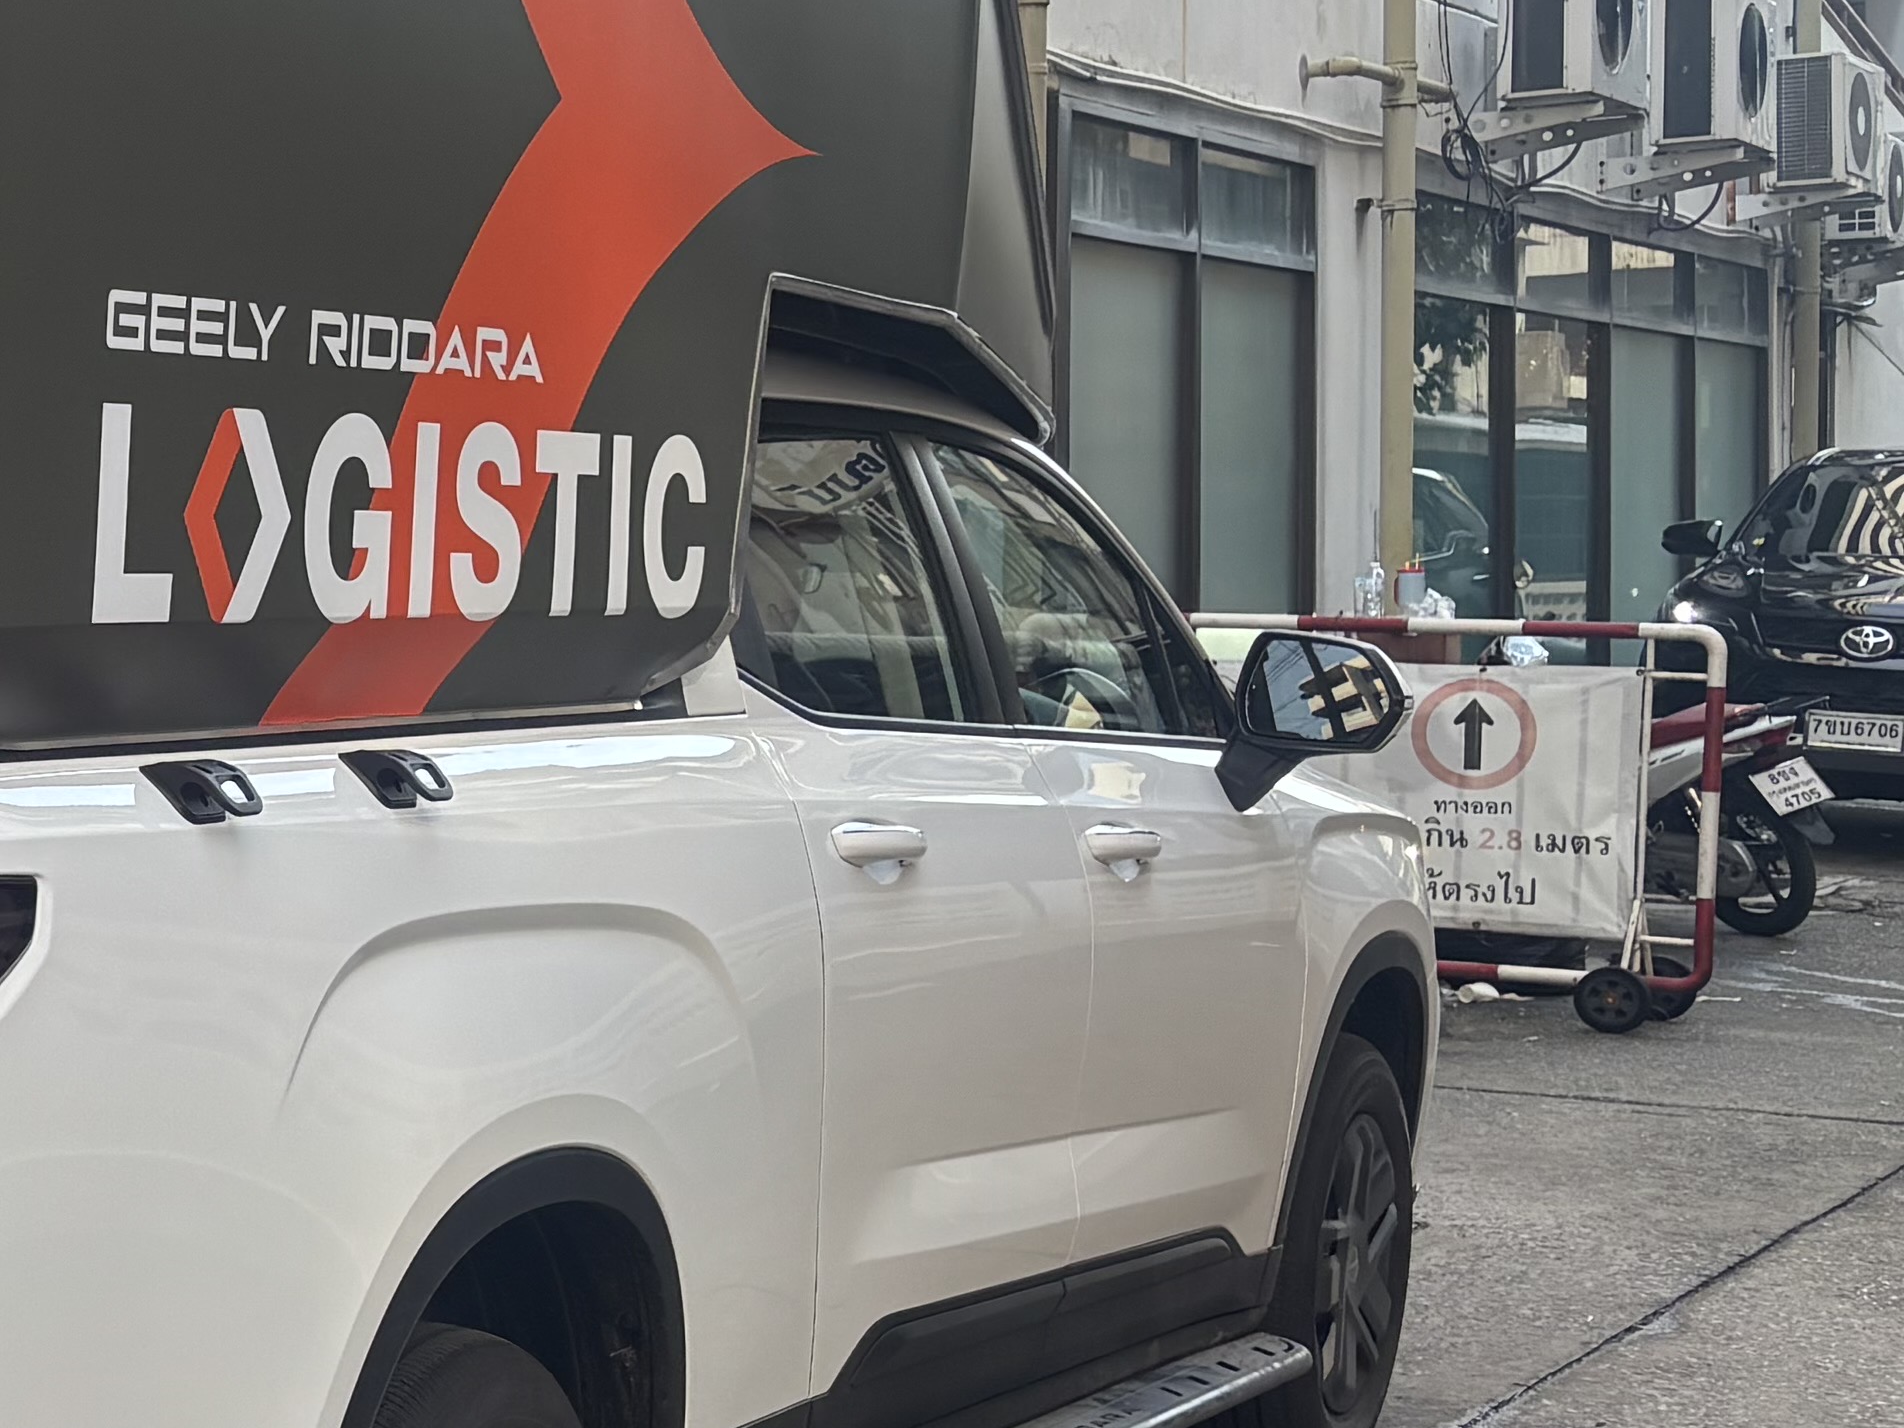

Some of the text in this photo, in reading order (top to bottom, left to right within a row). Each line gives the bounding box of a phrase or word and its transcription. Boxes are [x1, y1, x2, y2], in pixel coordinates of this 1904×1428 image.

[105, 288, 544, 384] GEELY RIDDARA
[1433, 799, 1513, 815] ทางออก
[1784, 787, 1822, 809] 4705
[1424, 817, 1612, 856] กิน 2.8 เมตร
